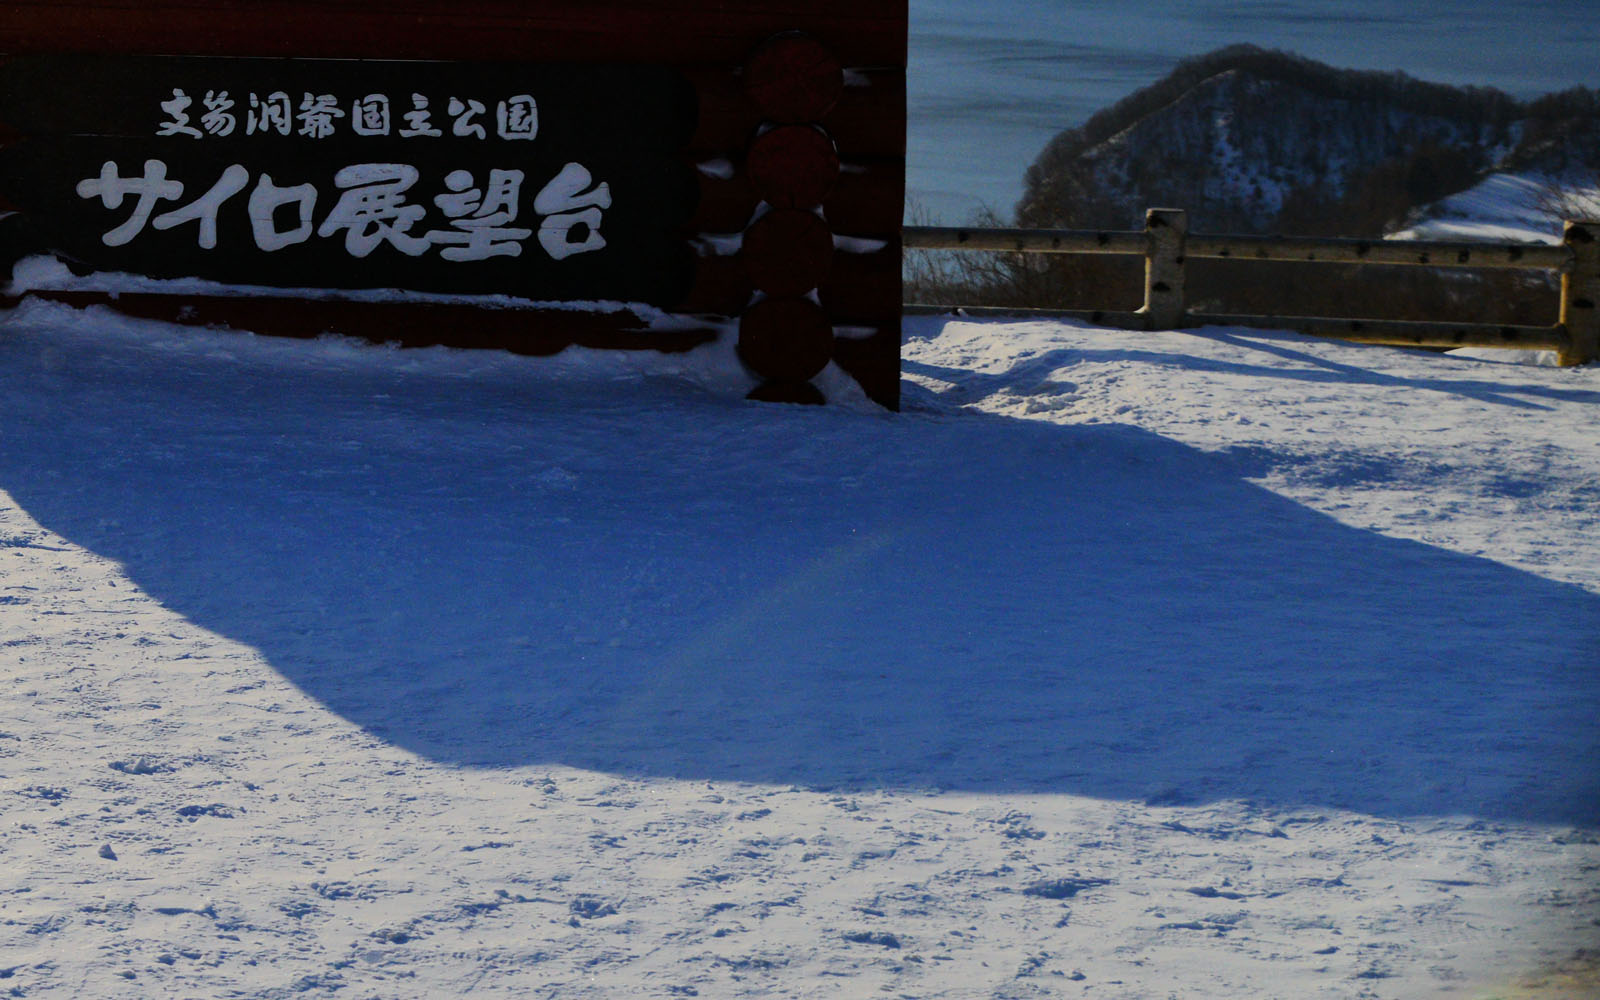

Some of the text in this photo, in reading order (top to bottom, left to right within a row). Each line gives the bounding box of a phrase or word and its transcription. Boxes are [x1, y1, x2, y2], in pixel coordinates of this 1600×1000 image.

[76, 159, 612, 262] サイロ展望台
